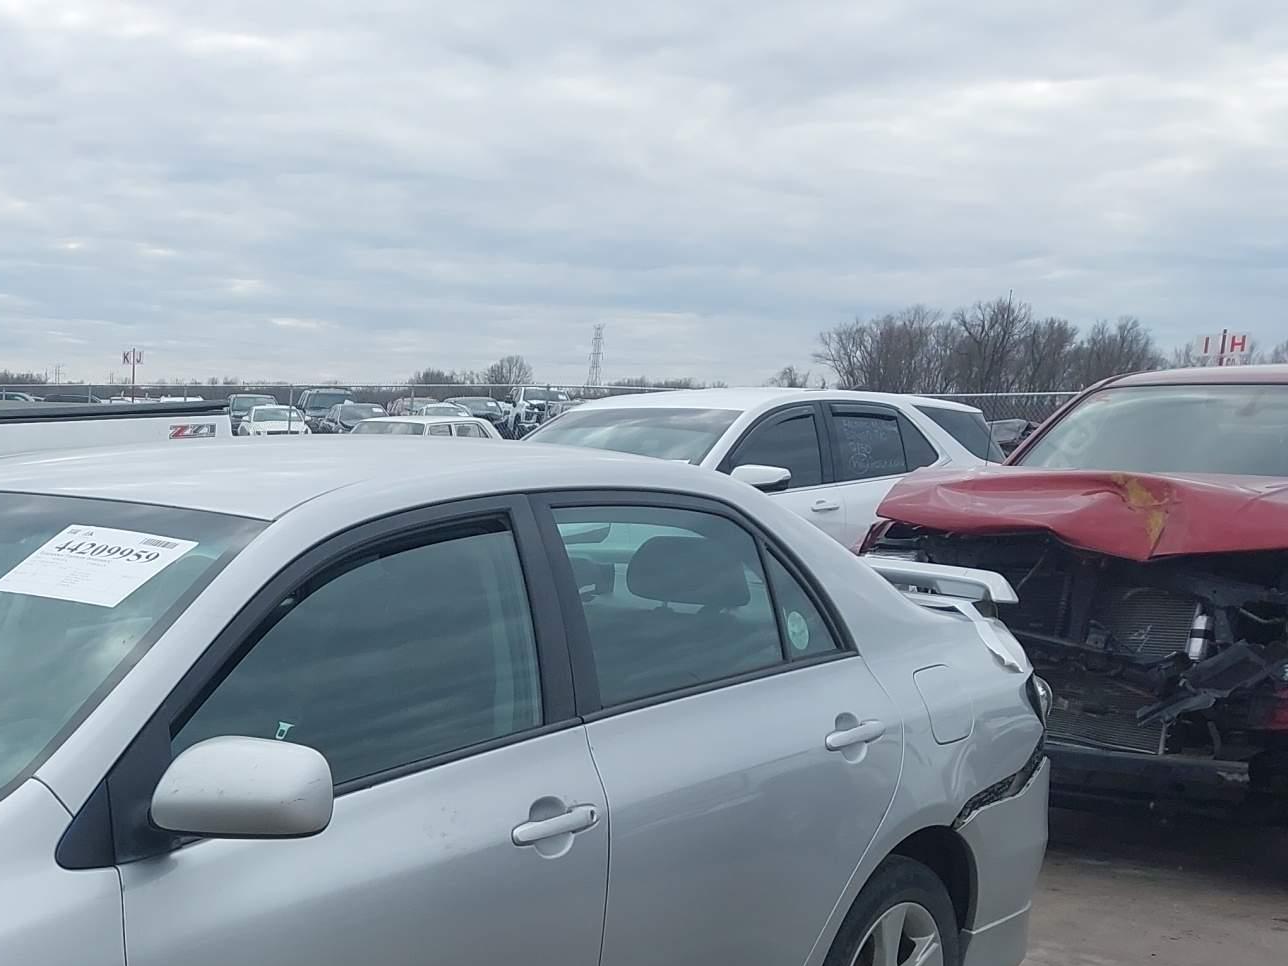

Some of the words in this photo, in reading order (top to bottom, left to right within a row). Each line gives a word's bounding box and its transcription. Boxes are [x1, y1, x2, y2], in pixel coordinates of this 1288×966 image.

[1230, 335, 1247, 352] H
[123, 351, 130, 364] K
[135, 351, 142, 364] J
[55, 540, 160, 563] 44209959
